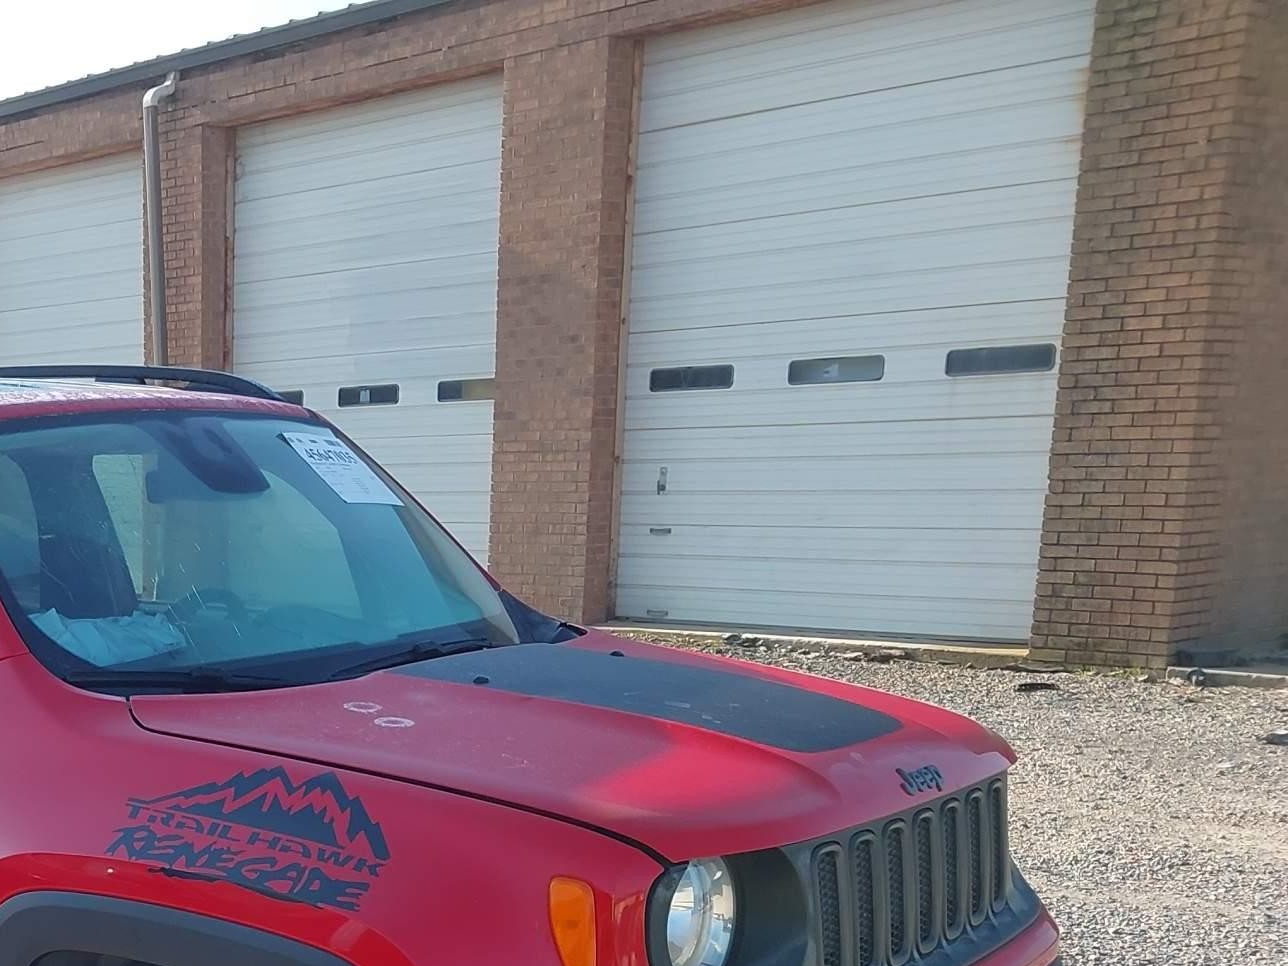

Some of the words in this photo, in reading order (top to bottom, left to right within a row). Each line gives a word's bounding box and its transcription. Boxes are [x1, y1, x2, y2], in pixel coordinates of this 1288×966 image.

[896, 765, 943, 796] Jeep
[105, 825, 370, 912] RENEGADE
[125, 801, 240, 842] TRAIL
[247, 832, 386, 878] HAWK
